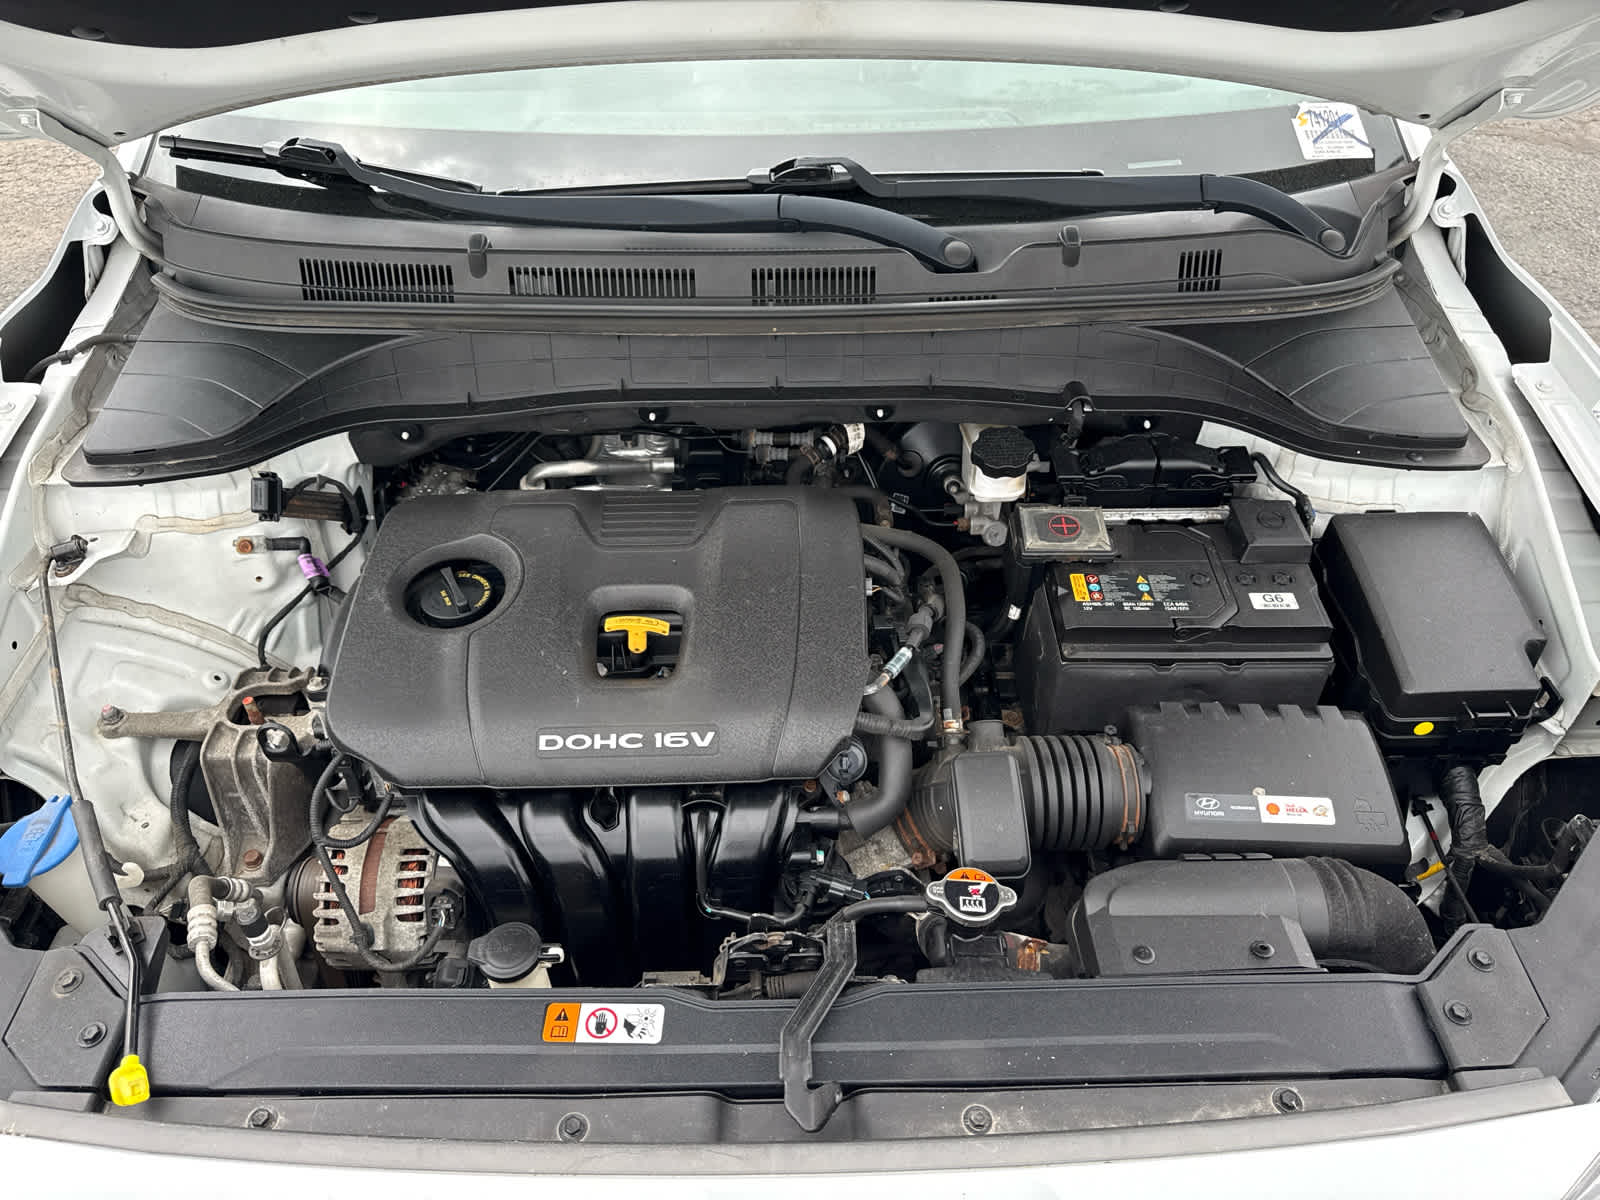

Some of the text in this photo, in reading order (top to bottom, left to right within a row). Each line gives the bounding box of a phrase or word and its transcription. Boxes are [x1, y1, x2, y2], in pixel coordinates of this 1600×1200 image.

[1262, 593, 1285, 603] G6
[538, 731, 716, 751] DOHC 16V
